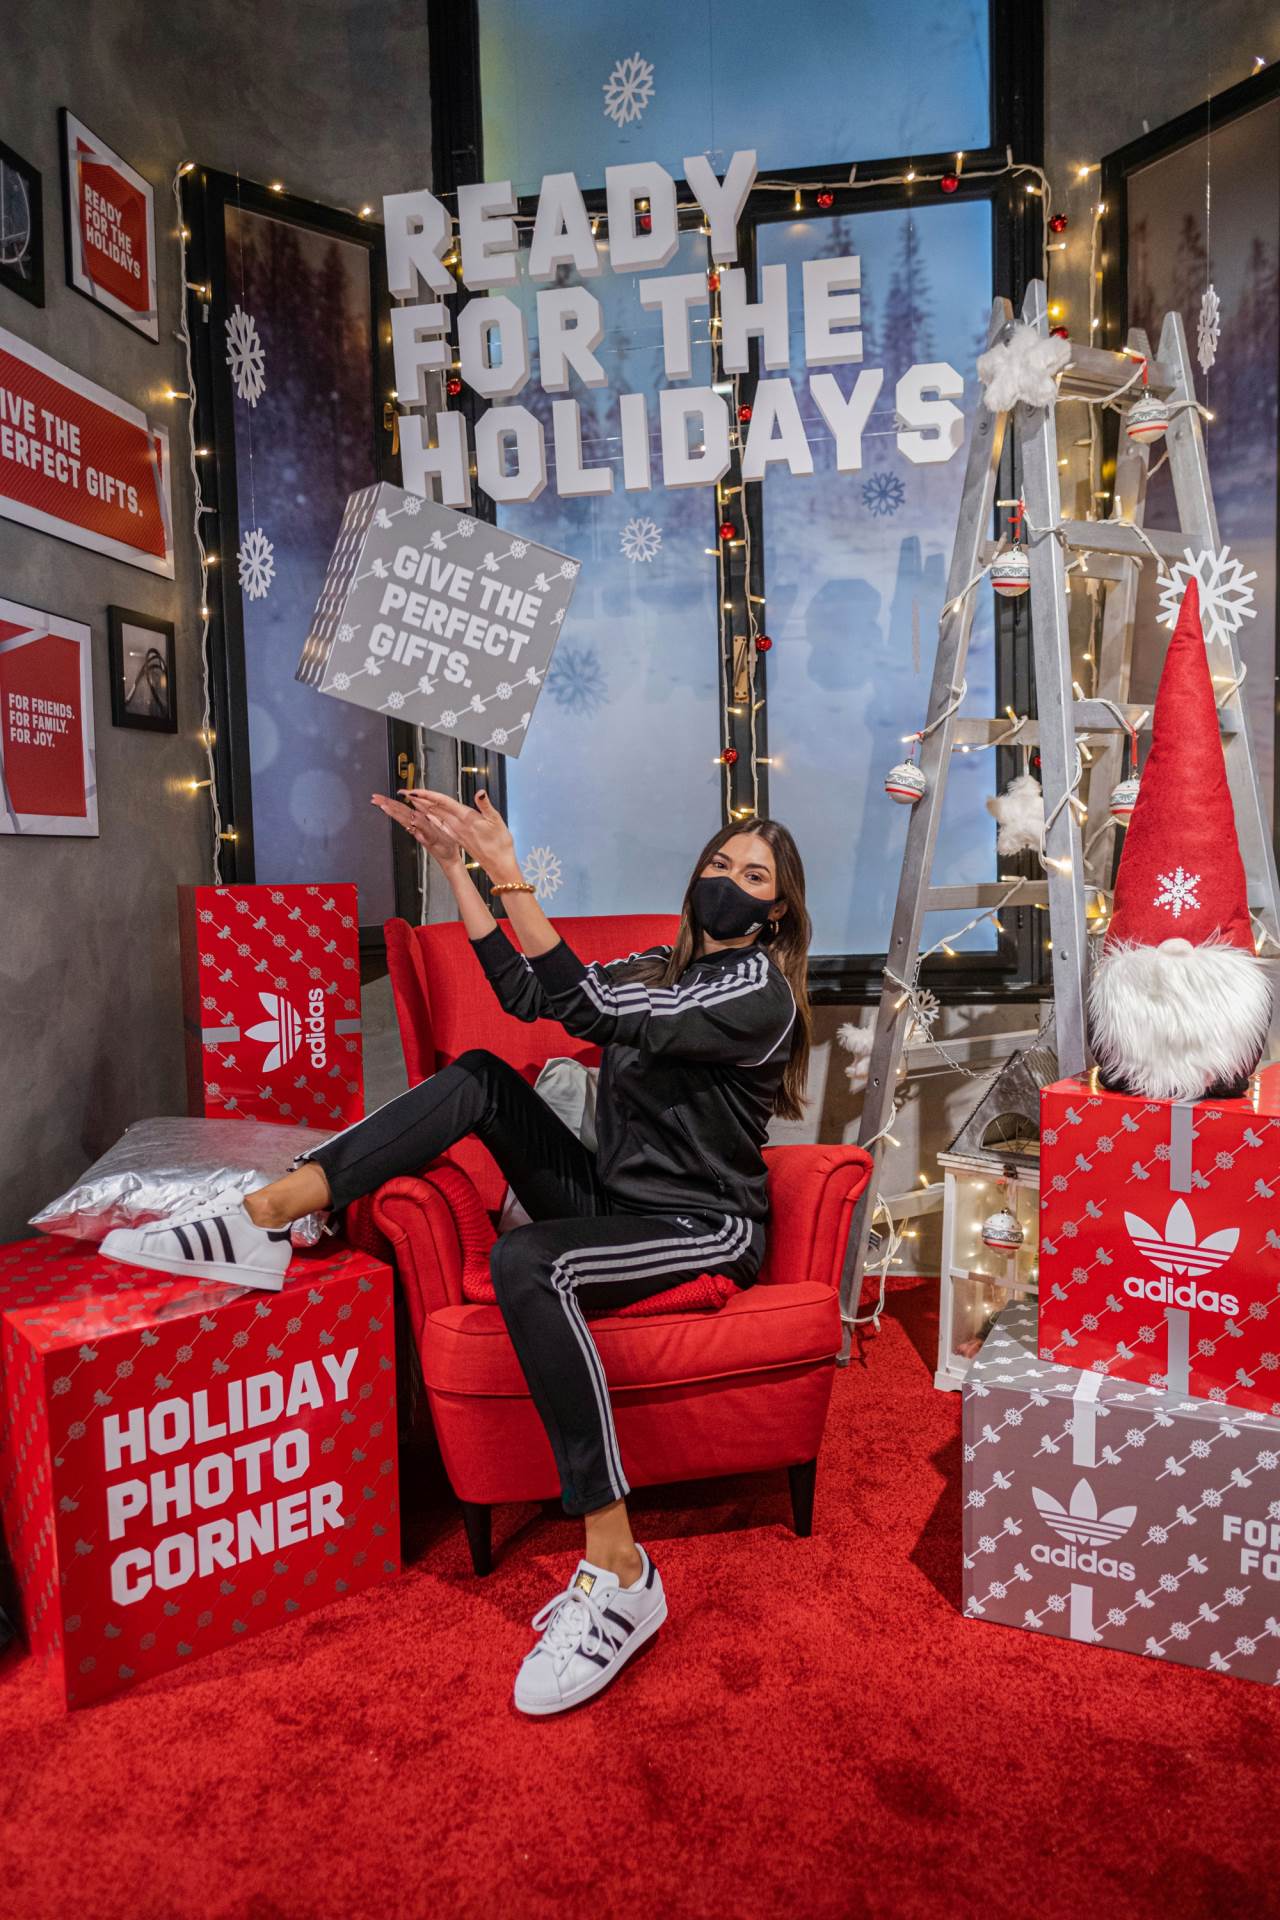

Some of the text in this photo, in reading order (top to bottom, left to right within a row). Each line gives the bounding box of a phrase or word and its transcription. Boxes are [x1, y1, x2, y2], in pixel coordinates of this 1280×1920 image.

[84, 183, 122, 228] READY
[85, 203, 132, 255] FOR THE
[383, 150, 758, 299] READY
[86, 222, 141, 279] HOLIDAYS
[391, 255, 864, 407] FOR THE
[41, 408, 81, 457] THE
[398, 362, 965, 508] HOLIDAYS
[0, 423, 144, 517] ERFECT GIFTS.
[379, 582, 530, 664] PERFECT
[393, 545, 543, 629] GIVE THE
[368, 622, 472, 688] GIFTS.
[8, 692, 75, 719] FOR FRIENDS.
[9, 709, 69, 734] FOR FAMILY.
[10, 726, 55, 748] FOR JOY.
[306, 988, 327, 1069] adidas
[1123, 1275, 1240, 1316] adidas
[102, 1347, 359, 1472] HOLIDAY
[106, 1428, 310, 1541] PHOTO
[110, 1480, 345, 1606] CORNER
[1030, 1543, 1136, 1582] adidas
